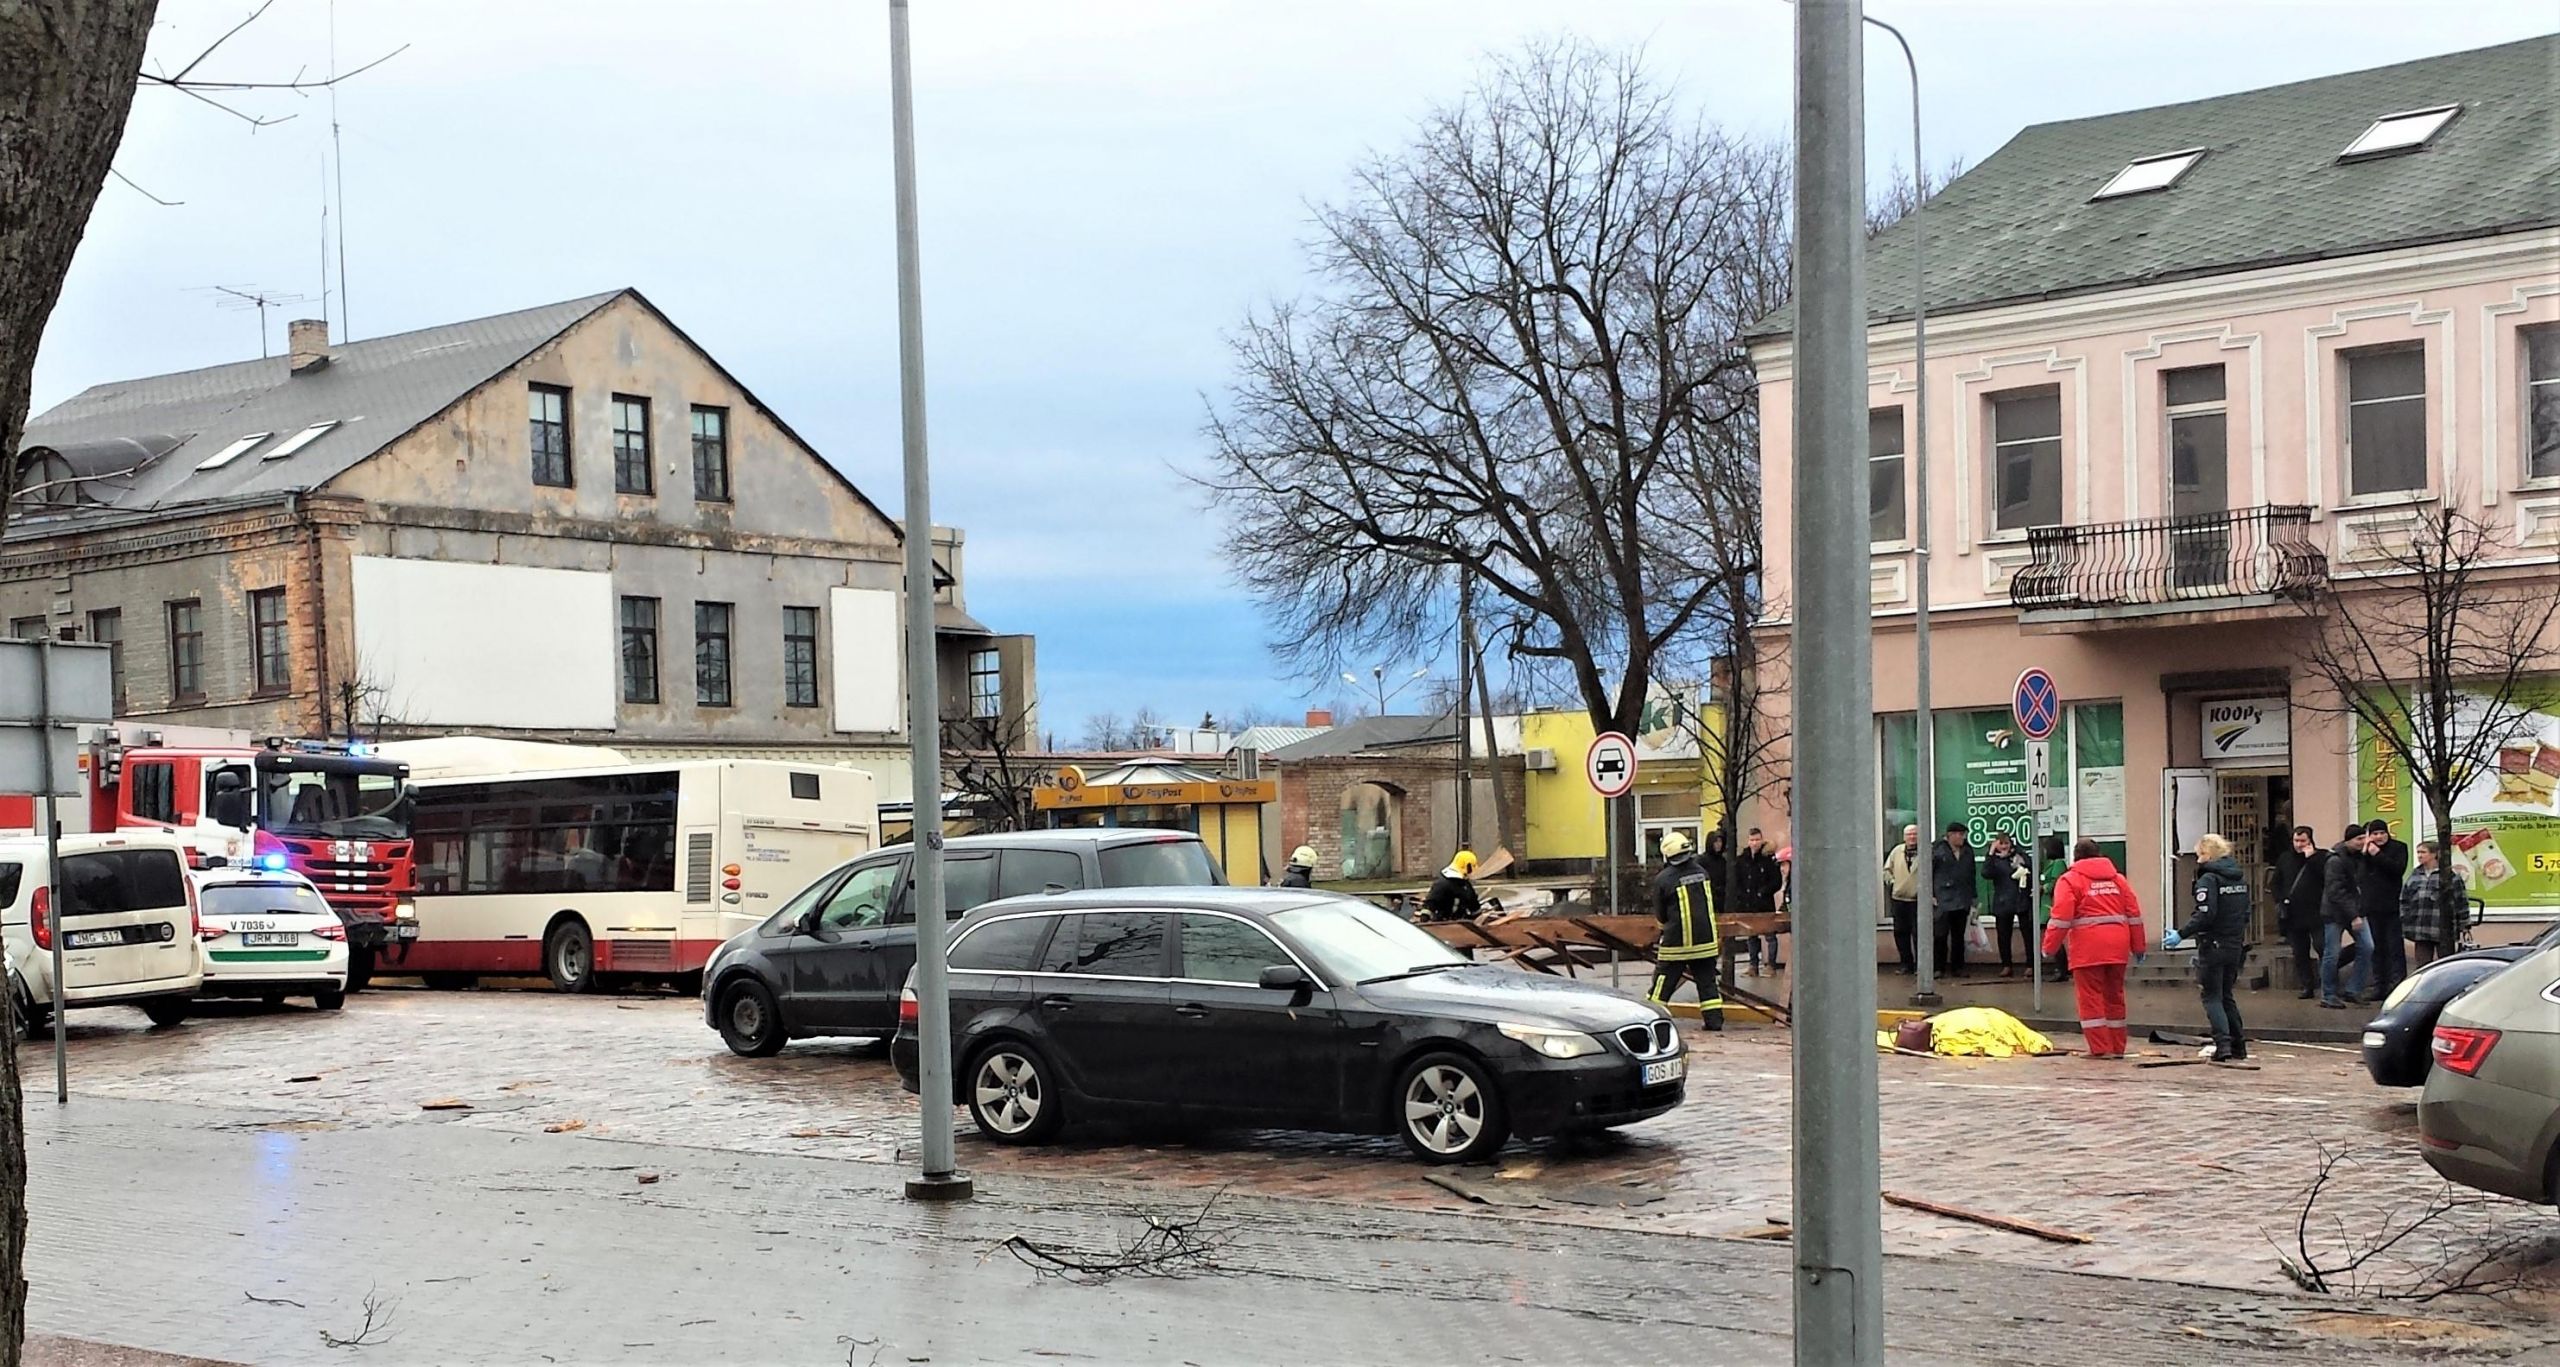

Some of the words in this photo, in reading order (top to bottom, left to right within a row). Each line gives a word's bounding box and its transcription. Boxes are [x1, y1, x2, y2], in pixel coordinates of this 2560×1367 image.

[2032, 772, 2047, 789] 40
[1966, 780, 2028, 797] Parduotuv
[2034, 793, 2045, 805] m
[1967, 815, 2033, 848] 8-20
[326, 844, 376, 857] SCANIA
[230, 920, 237, 930] V
[240, 920, 265, 930] 7036
[75, 934, 97, 944] JMG
[102, 931, 120, 942] 617
[250, 933, 272, 943] JRM
[1648, 1063, 1667, 1081] GOS
